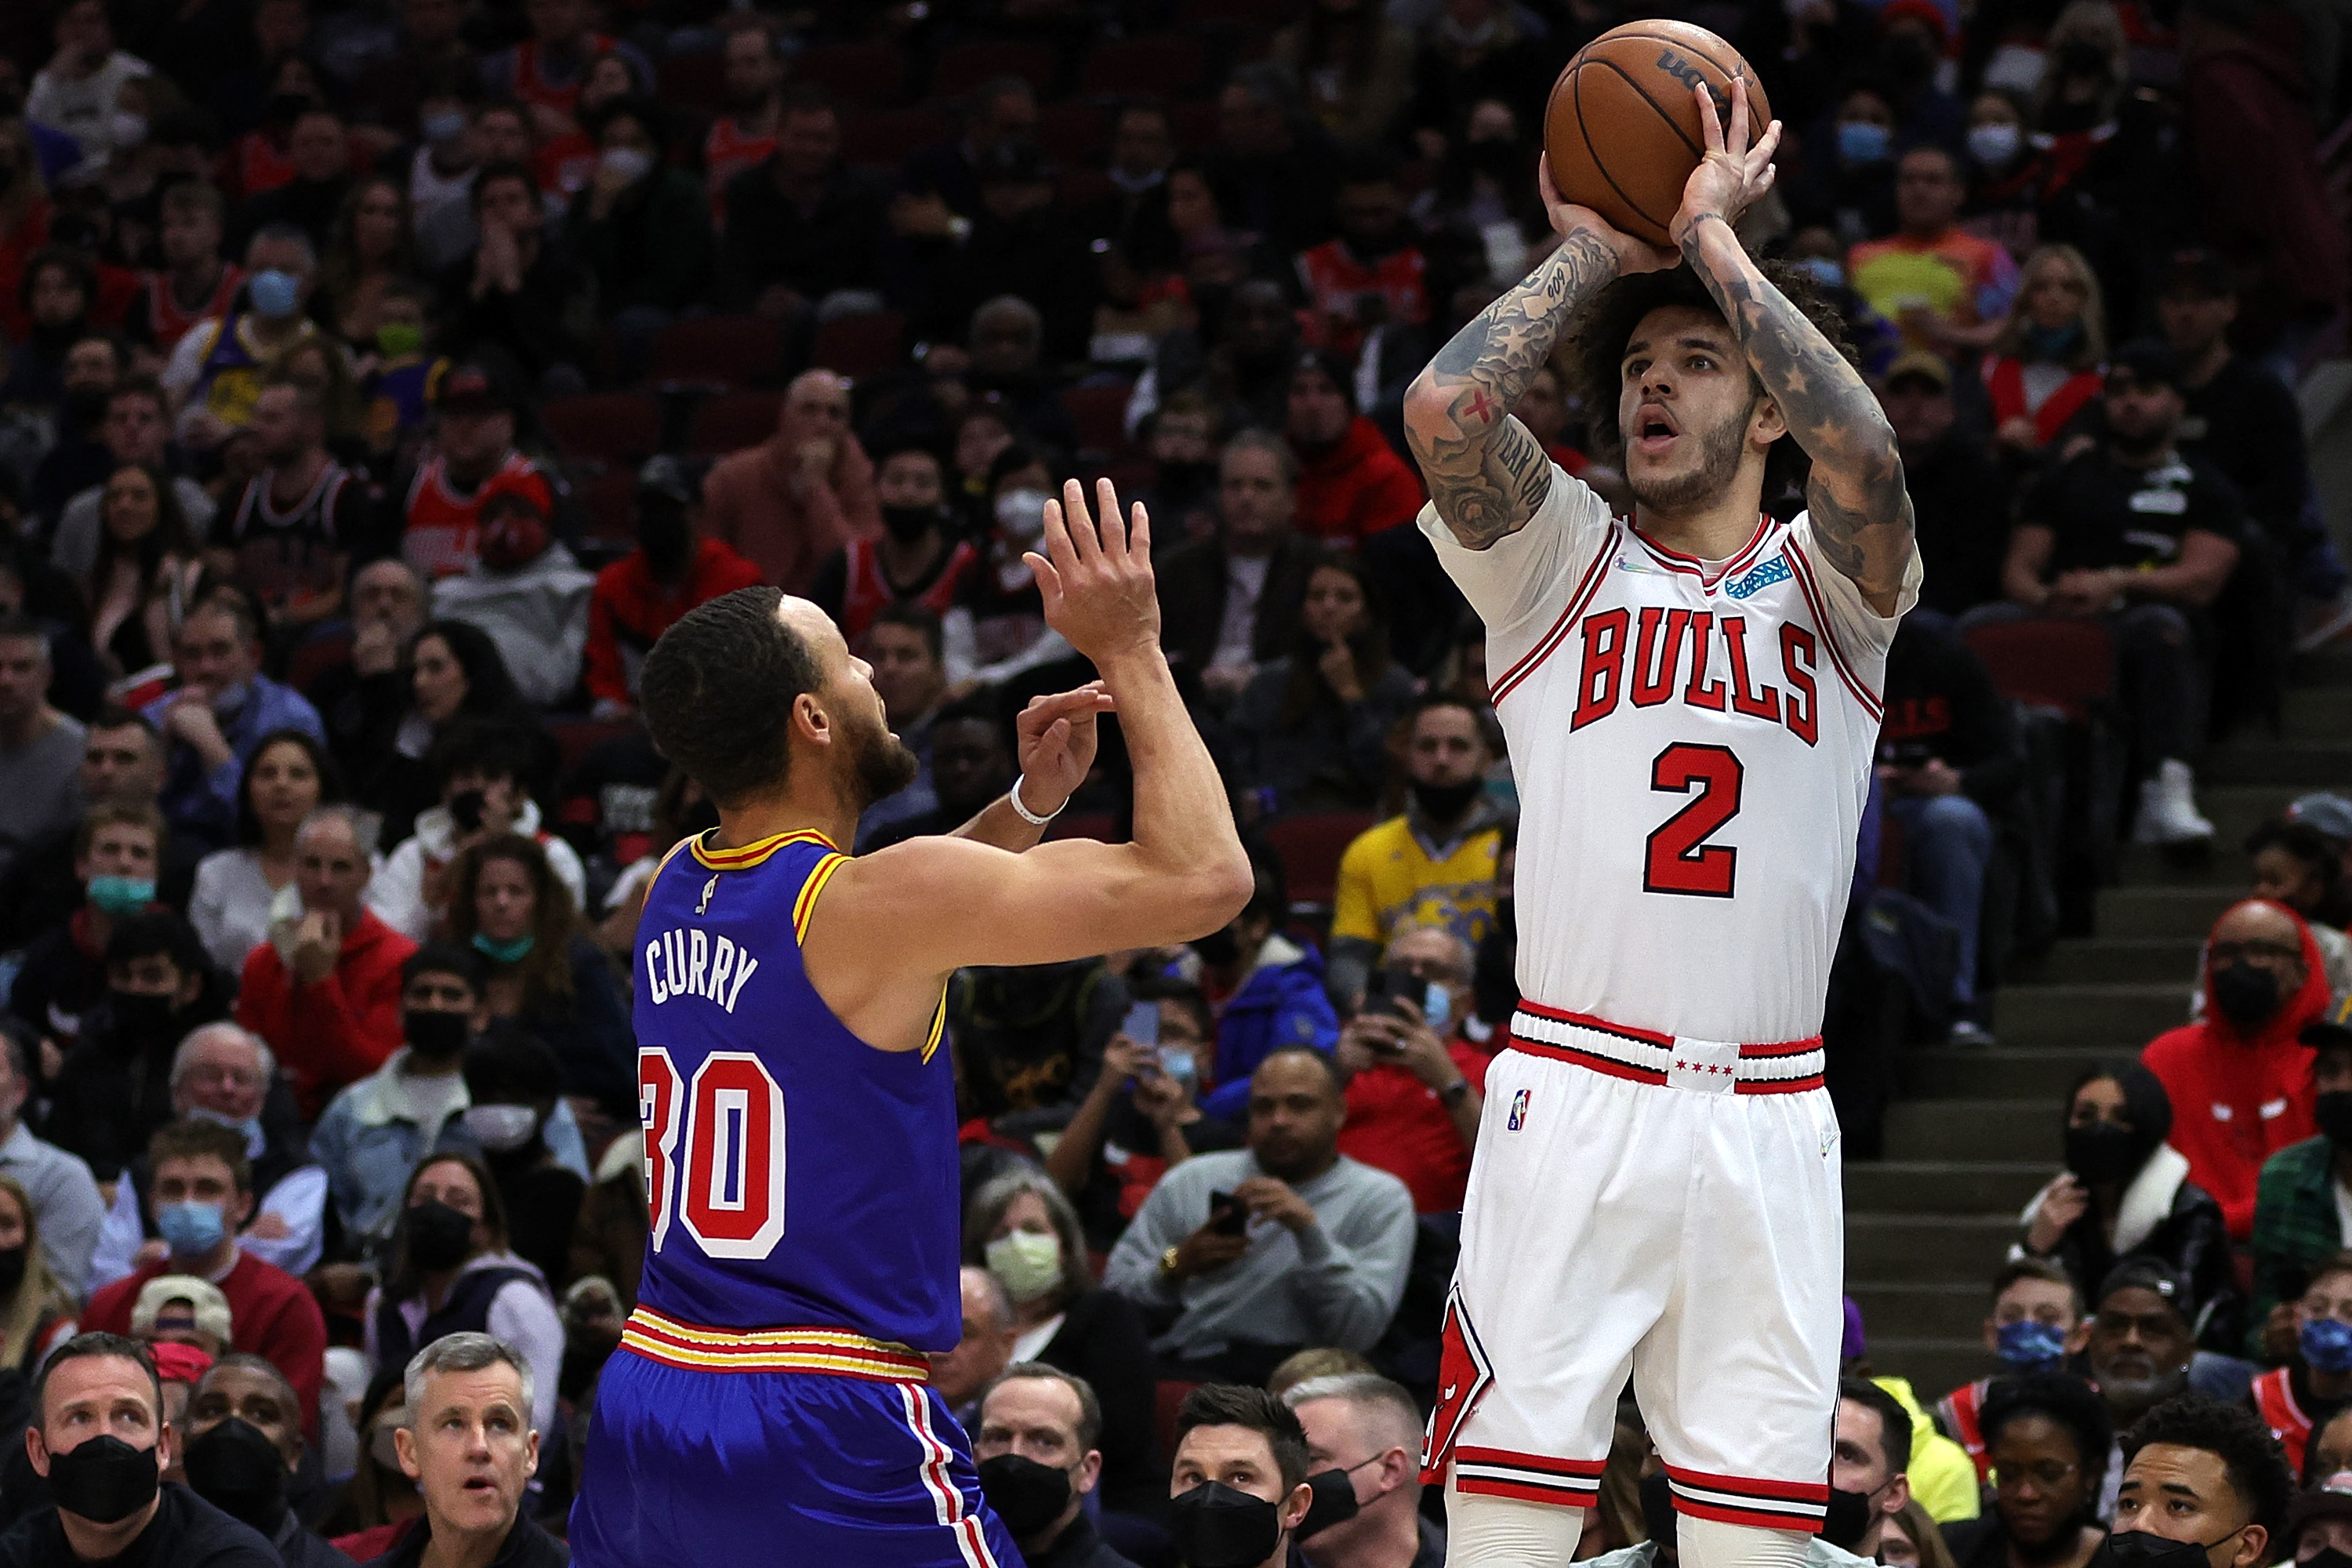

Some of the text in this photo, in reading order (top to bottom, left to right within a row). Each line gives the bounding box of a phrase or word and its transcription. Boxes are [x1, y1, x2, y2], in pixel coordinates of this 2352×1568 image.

[1548, 267, 1566, 303] 909
[1513, 452, 1552, 515] GO
[1570, 606, 1819, 748] BULLS
[1643, 742, 1744, 898] 2
[646, 928, 759, 1014] CURRY
